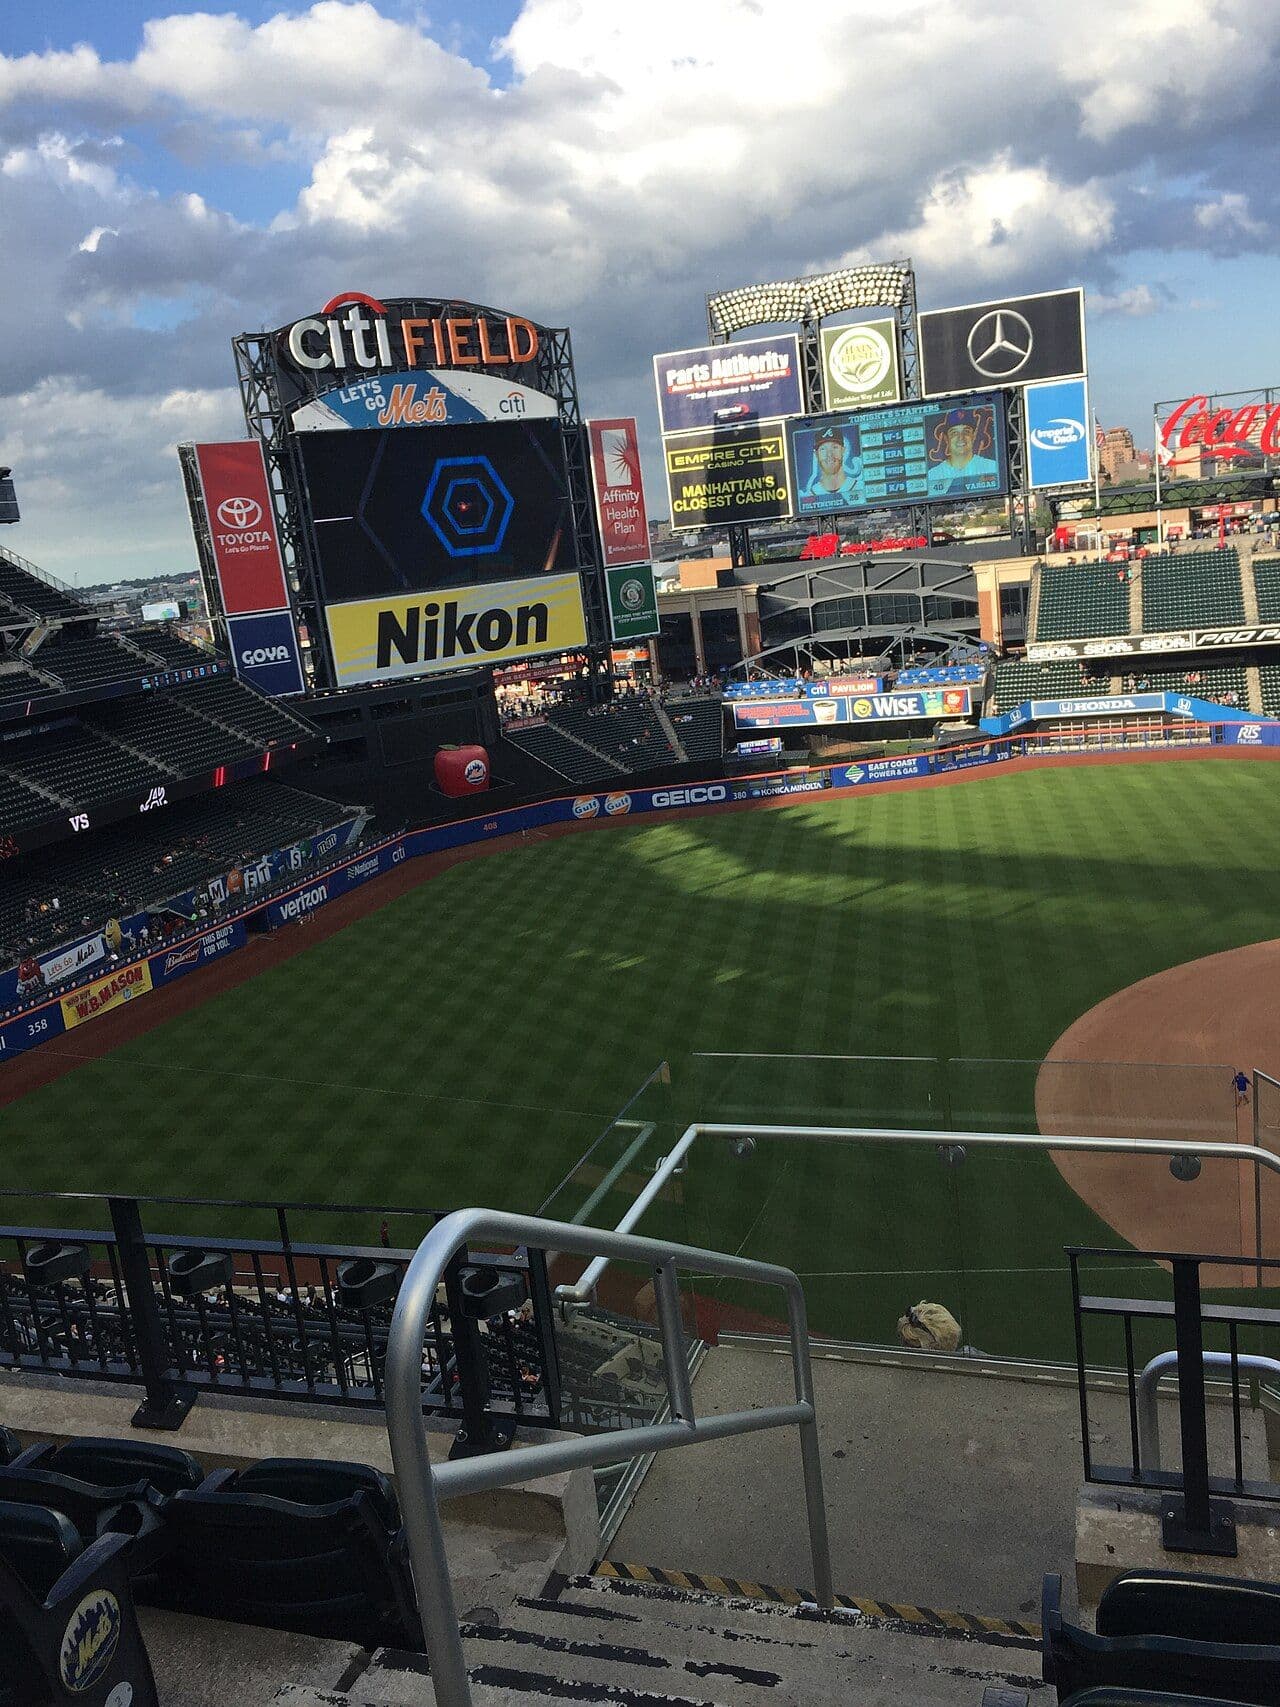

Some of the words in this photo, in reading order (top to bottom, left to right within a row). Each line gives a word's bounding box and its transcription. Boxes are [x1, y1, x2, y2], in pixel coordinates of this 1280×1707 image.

[289, 305, 392, 369] citi
[399, 317, 539, 367] FIELD
[665, 364, 710, 387] Parts
[711, 350, 790, 379] Authority
[339, 379, 382, 405] LET'S
[364, 393, 386, 411] GO
[377, 383, 448, 427] Mets
[498, 395, 526, 414] citi
[848, 409, 895, 424] TONIGHT'S
[895, 403, 940, 417] STARTERS
[883, 432, 902, 441] W-L
[674, 449, 736, 466] EMPIRE
[884, 450, 903, 459] ERA
[707, 460, 744, 470] CASINO
[682, 476, 775, 499] MANHATTAN'S
[965, 480, 996, 491] VARGAS
[603, 489, 640, 504] Affinity
[673, 494, 732, 513] CLOSEST
[735, 487, 787, 505] CASINO
[606, 506, 640, 521] Health
[614, 521, 635, 534] Plan
[217, 531, 272, 546] TOYOTA
[249, 544, 270, 552] Places
[376, 601, 549, 669] Nikon
[1196, 631, 1257, 645] PRO
[241, 645, 291, 665] GOYA
[810, 682, 827, 695] citi
[831, 682, 874, 693] PAVILION
[1074, 698, 1136, 712] HONDA
[1237, 725, 1262, 739] RTS
[996, 751, 1009, 761] 370
[868, 761, 889, 772] EAST
[890, 758, 918, 769] COAST
[868, 770, 896, 780] POWER
[903, 766, 919, 775] GAS
[652, 785, 726, 808] GEICO
[733, 791, 747, 800] 380
[761, 786, 790, 797] KONICA
[790, 782, 823, 793] MINOLTA
[574, 801, 599, 814] Gulf
[606, 798, 630, 811] Gulf
[68, 813, 91, 833] VS
[483, 822, 498, 831] 408
[391, 847, 406, 864] citi
[279, 885, 328, 920] verizon
[202, 935, 216, 946] THIS
[216, 925, 234, 940] BUD'S
[204, 945, 217, 957] FOR
[28, 1019, 49, 1037] 358
